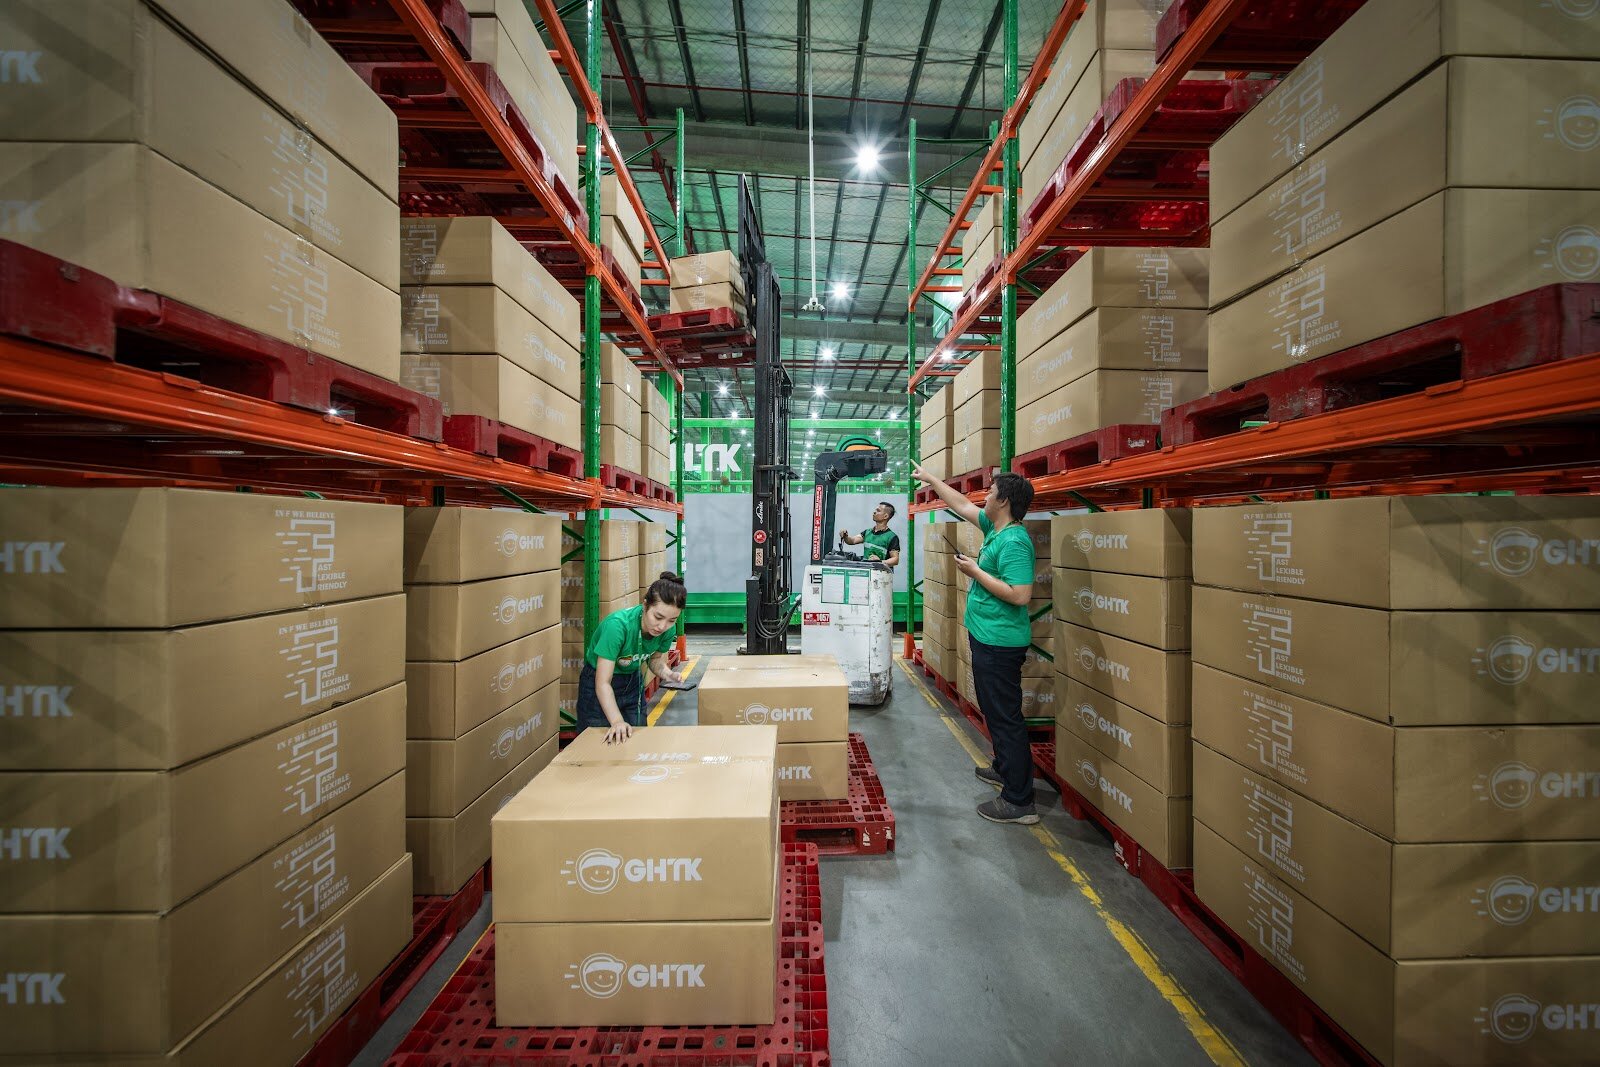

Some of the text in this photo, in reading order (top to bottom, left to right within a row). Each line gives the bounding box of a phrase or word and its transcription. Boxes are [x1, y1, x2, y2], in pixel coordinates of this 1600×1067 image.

[1046, 291, 1069, 319] GHTK
[543, 348, 566, 372] GHTK
[1048, 346, 1072, 372] GHTK
[1047, 404, 1072, 424] GHTK
[519, 534, 544, 549] GHTK
[1095, 534, 1128, 550] GHTK
[517, 594, 544, 614] GHTK
[1096, 596, 1130, 614] GHTK
[516, 654, 543, 678] GHTK
[1097, 656, 1130, 682] GHTK
[515, 712, 542, 741] GHTK
[770, 707, 813, 722] GHTK
[1098, 718, 1132, 748] GHTK
[1099, 776, 1133, 814] GHTK
[624, 858, 702, 882] GHTK
[628, 964, 705, 988] GHTK
